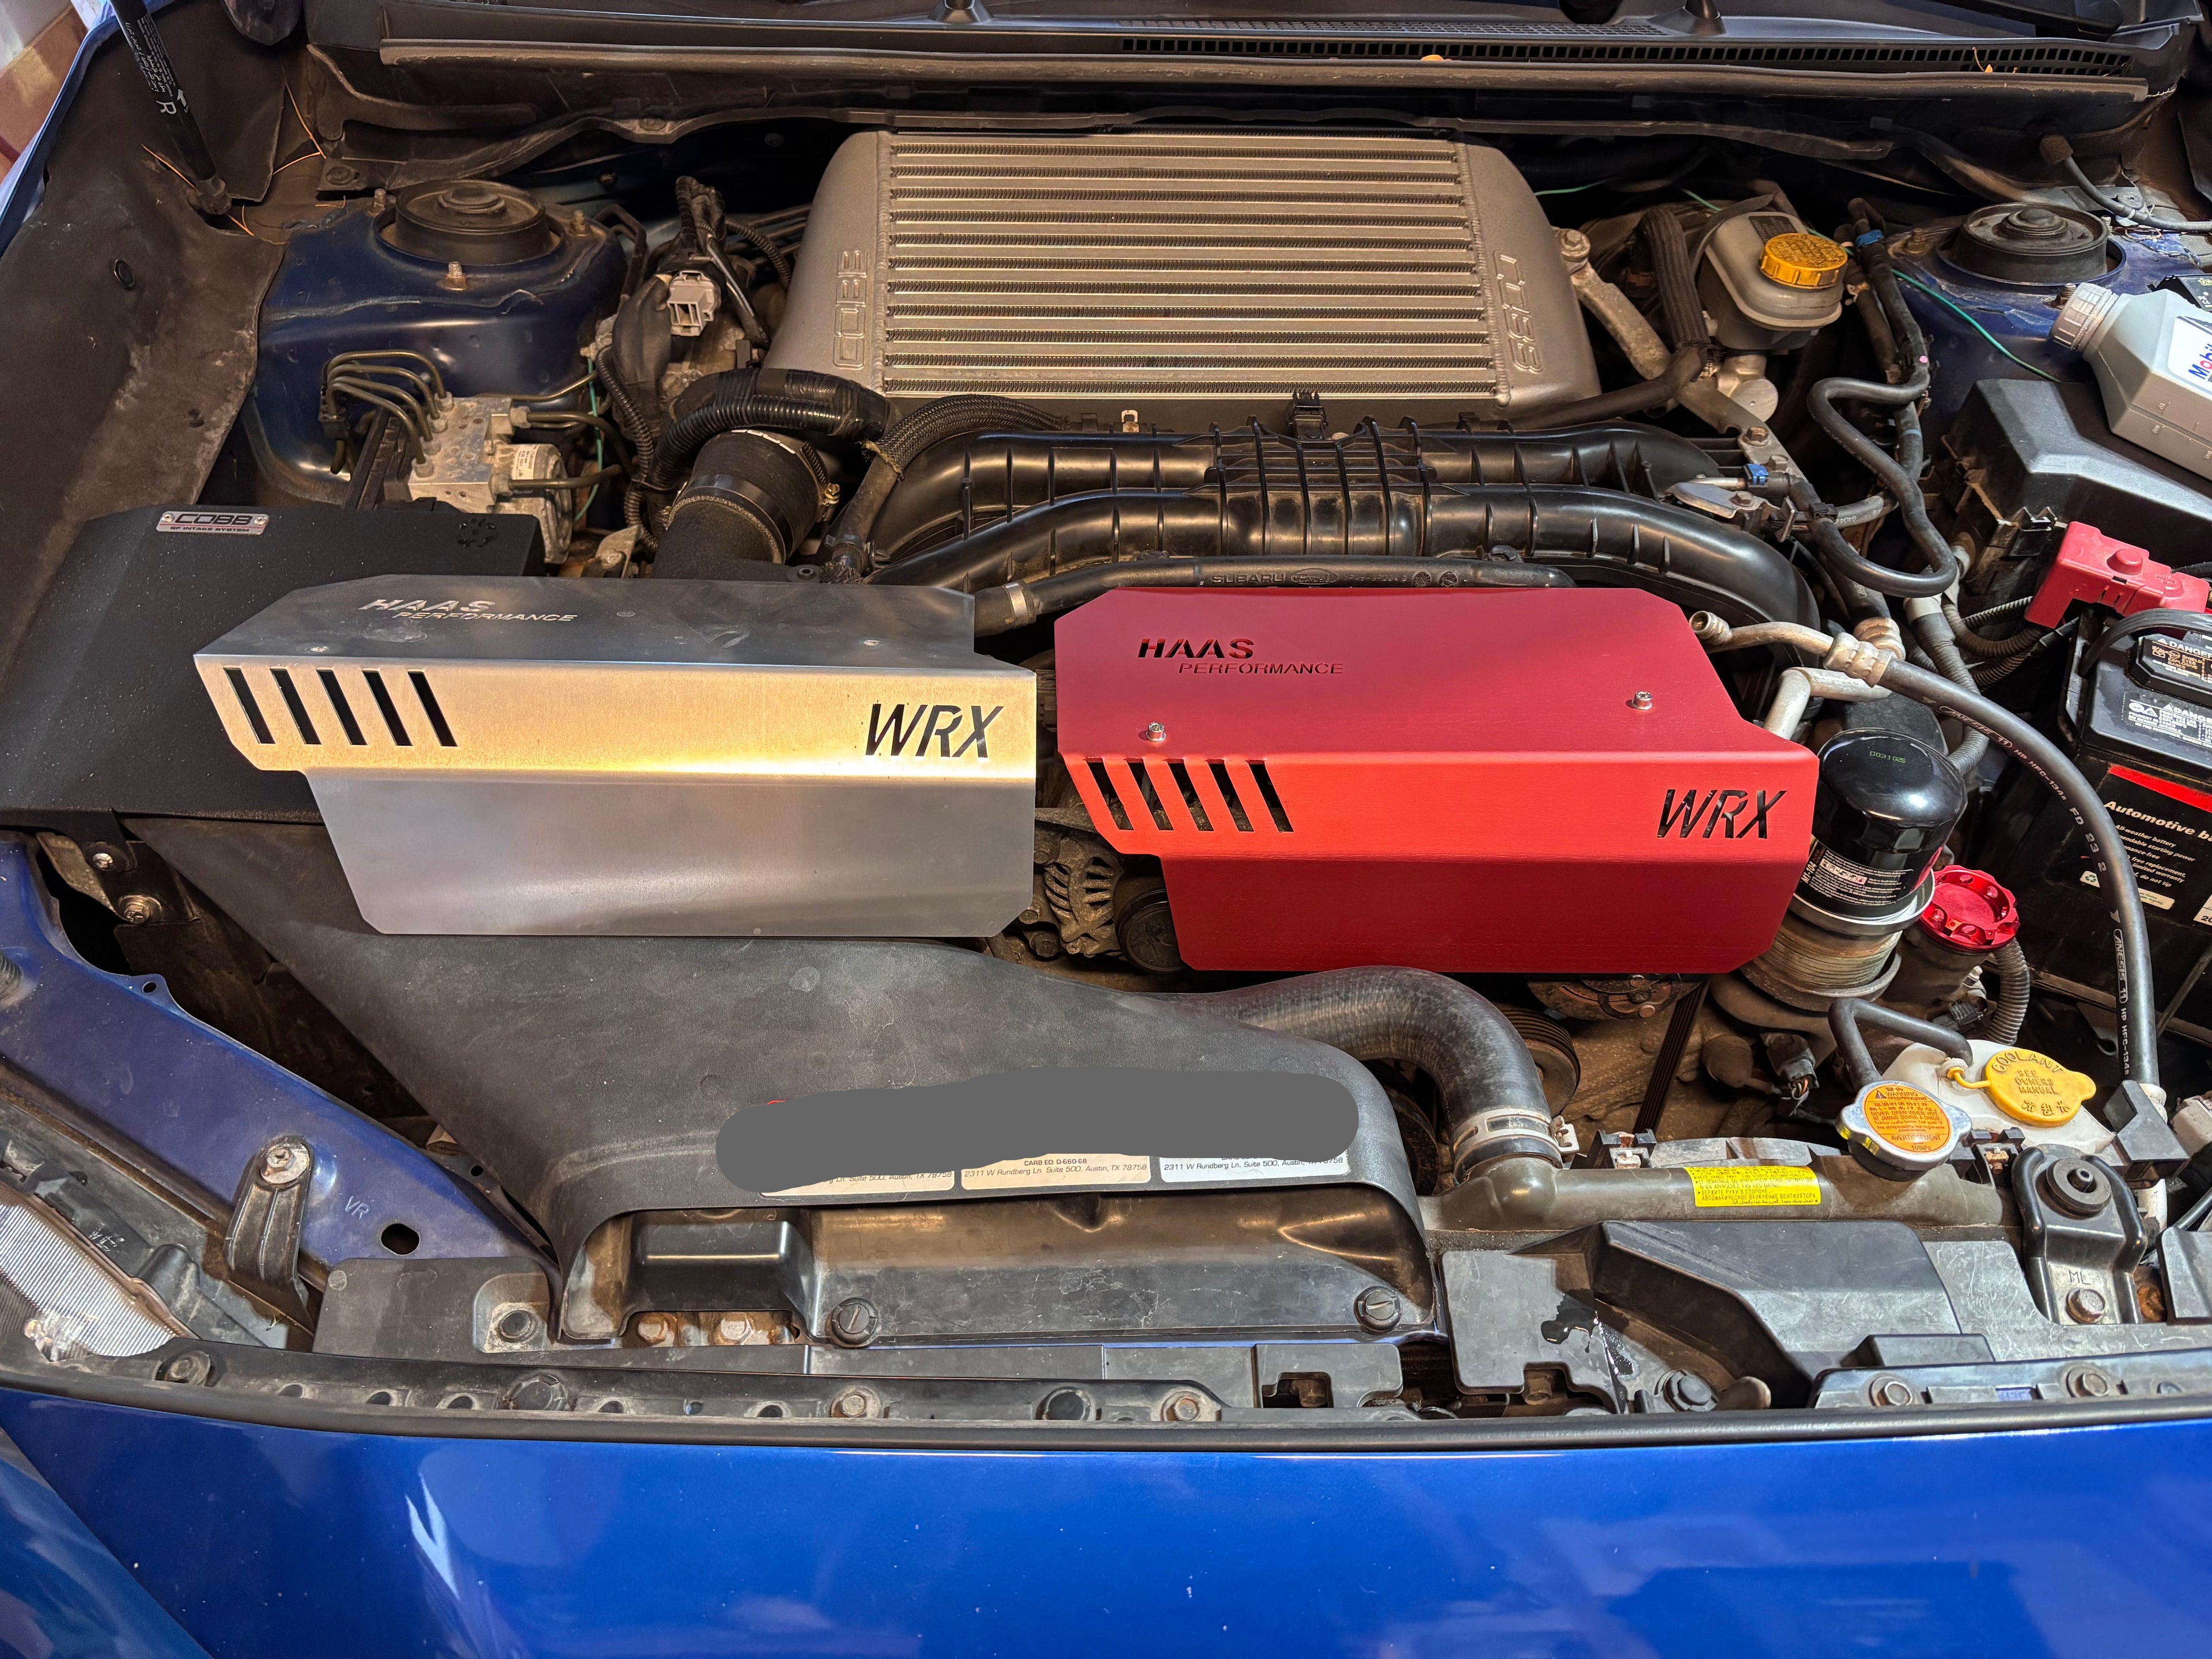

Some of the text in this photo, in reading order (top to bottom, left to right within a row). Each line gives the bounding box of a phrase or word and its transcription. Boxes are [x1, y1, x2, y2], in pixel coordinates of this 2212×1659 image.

[156, 100, 177, 115] R
[834, 249, 868, 370] COBB
[2188, 343, 2212, 380] Mob
[175, 513, 253, 525] COBB
[1211, 573, 1286, 584] SUBARU
[358, 599, 496, 612] HAAS
[392, 612, 577, 622] PERFORMANCE
[1138, 638, 1255, 659] HAAS
[1179, 662, 1343, 675] PERFORMANCE
[865, 703, 1005, 758] WRX
[1657, 789, 1787, 839] WRX
[2014, 749, 2028, 759] HP
[2028, 760, 2067, 801] HFC-134a
[2069, 807, 2084, 825] FD
[2085, 832, 2099, 853] 23
[2097, 862, 2107, 872] 2
[2103, 801, 2195, 835] Automotive
[2115, 824, 2177, 848] All-weather battery
[2147, 844, 2173, 856] starting
[2173, 853, 2196, 862] power
[2132, 863, 2185, 884] limited warranty
[2146, 861, 2187, 878] replacement,
[2120, 1007, 2127, 1021] HP
[1991, 1051, 2064, 1073] COOLANT
[2015, 1078, 2054, 1086] OWNERS
[2017, 1069, 2039, 1078] SEE
[2018, 1086, 2061, 1095] MANUAL
[344, 1195, 370, 1219] VR
[2068, 1268, 2091, 1285] ML
